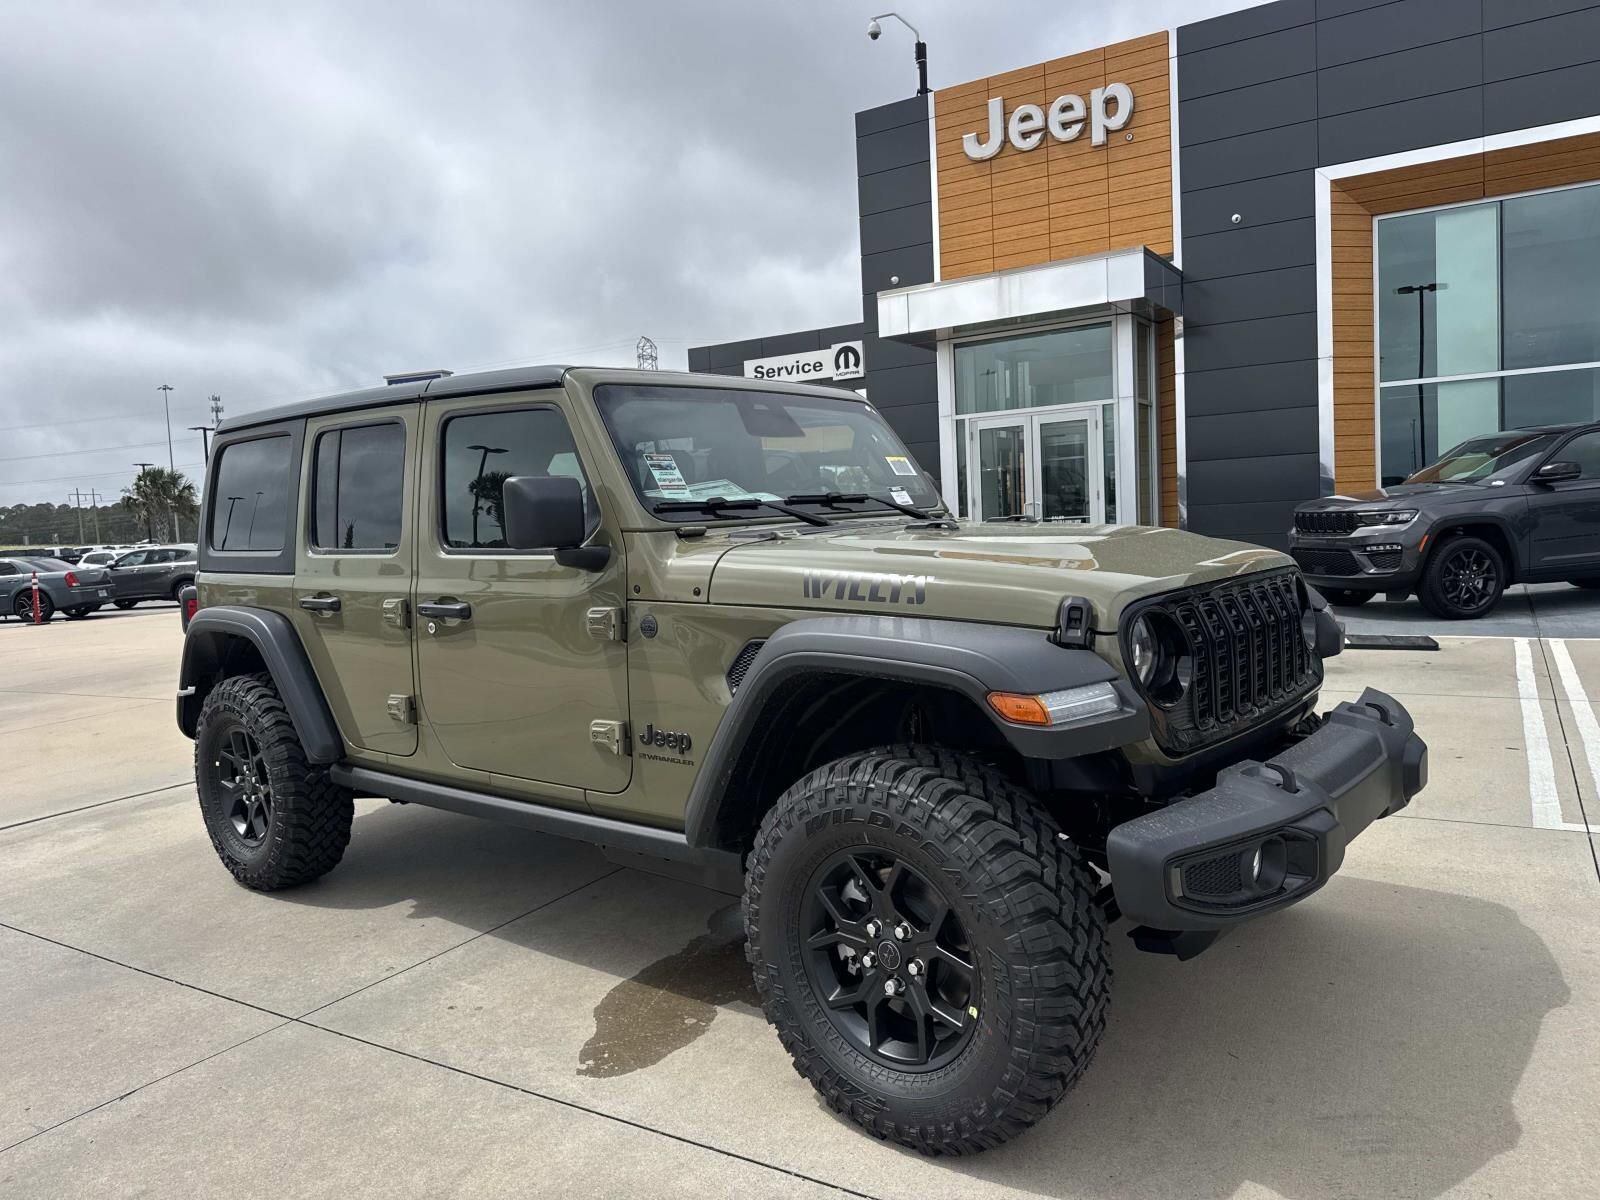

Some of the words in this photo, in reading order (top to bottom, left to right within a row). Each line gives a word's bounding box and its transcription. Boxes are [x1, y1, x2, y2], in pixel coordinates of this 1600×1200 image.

[962, 82, 1134, 161] Jeep
[754, 361, 823, 379] Service
[639, 723, 692, 755] Jeep
[646, 753, 694, 766] WRANGLER
